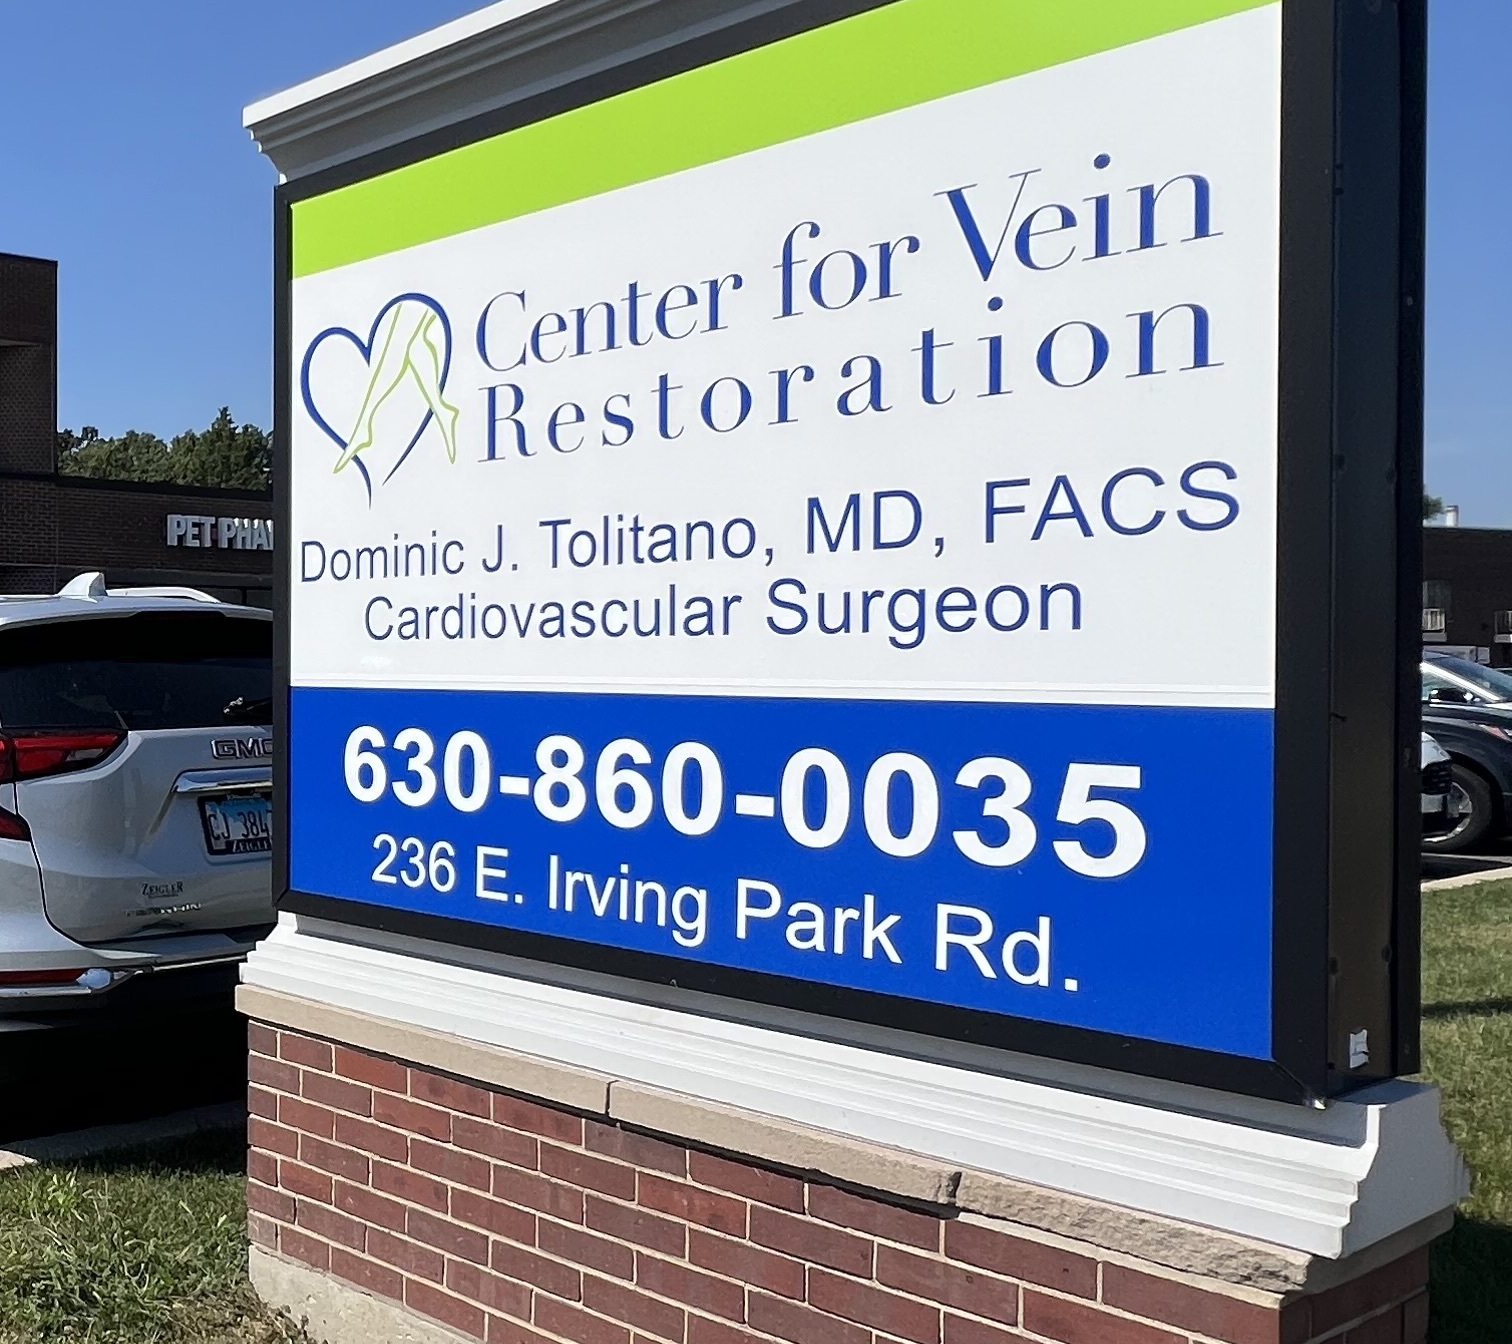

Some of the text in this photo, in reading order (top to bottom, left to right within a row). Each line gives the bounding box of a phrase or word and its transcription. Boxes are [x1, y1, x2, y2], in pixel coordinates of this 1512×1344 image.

[475, 153, 1224, 372] Center for Vein
[477, 296, 1224, 463] Restoration
[167, 514, 216, 548] PET
[300, 460, 1241, 583] Dominic J. Tolitano, MD, FACS
[365, 577, 1083, 650] Cardiovascular Surgeon
[208, 812, 231, 842] CJ
[344, 725, 1148, 879] 630-860-0035
[141, 880, 184, 896] ZEIGLER
[371, 833, 1079, 993] 236 E. Irving Park Rd.
